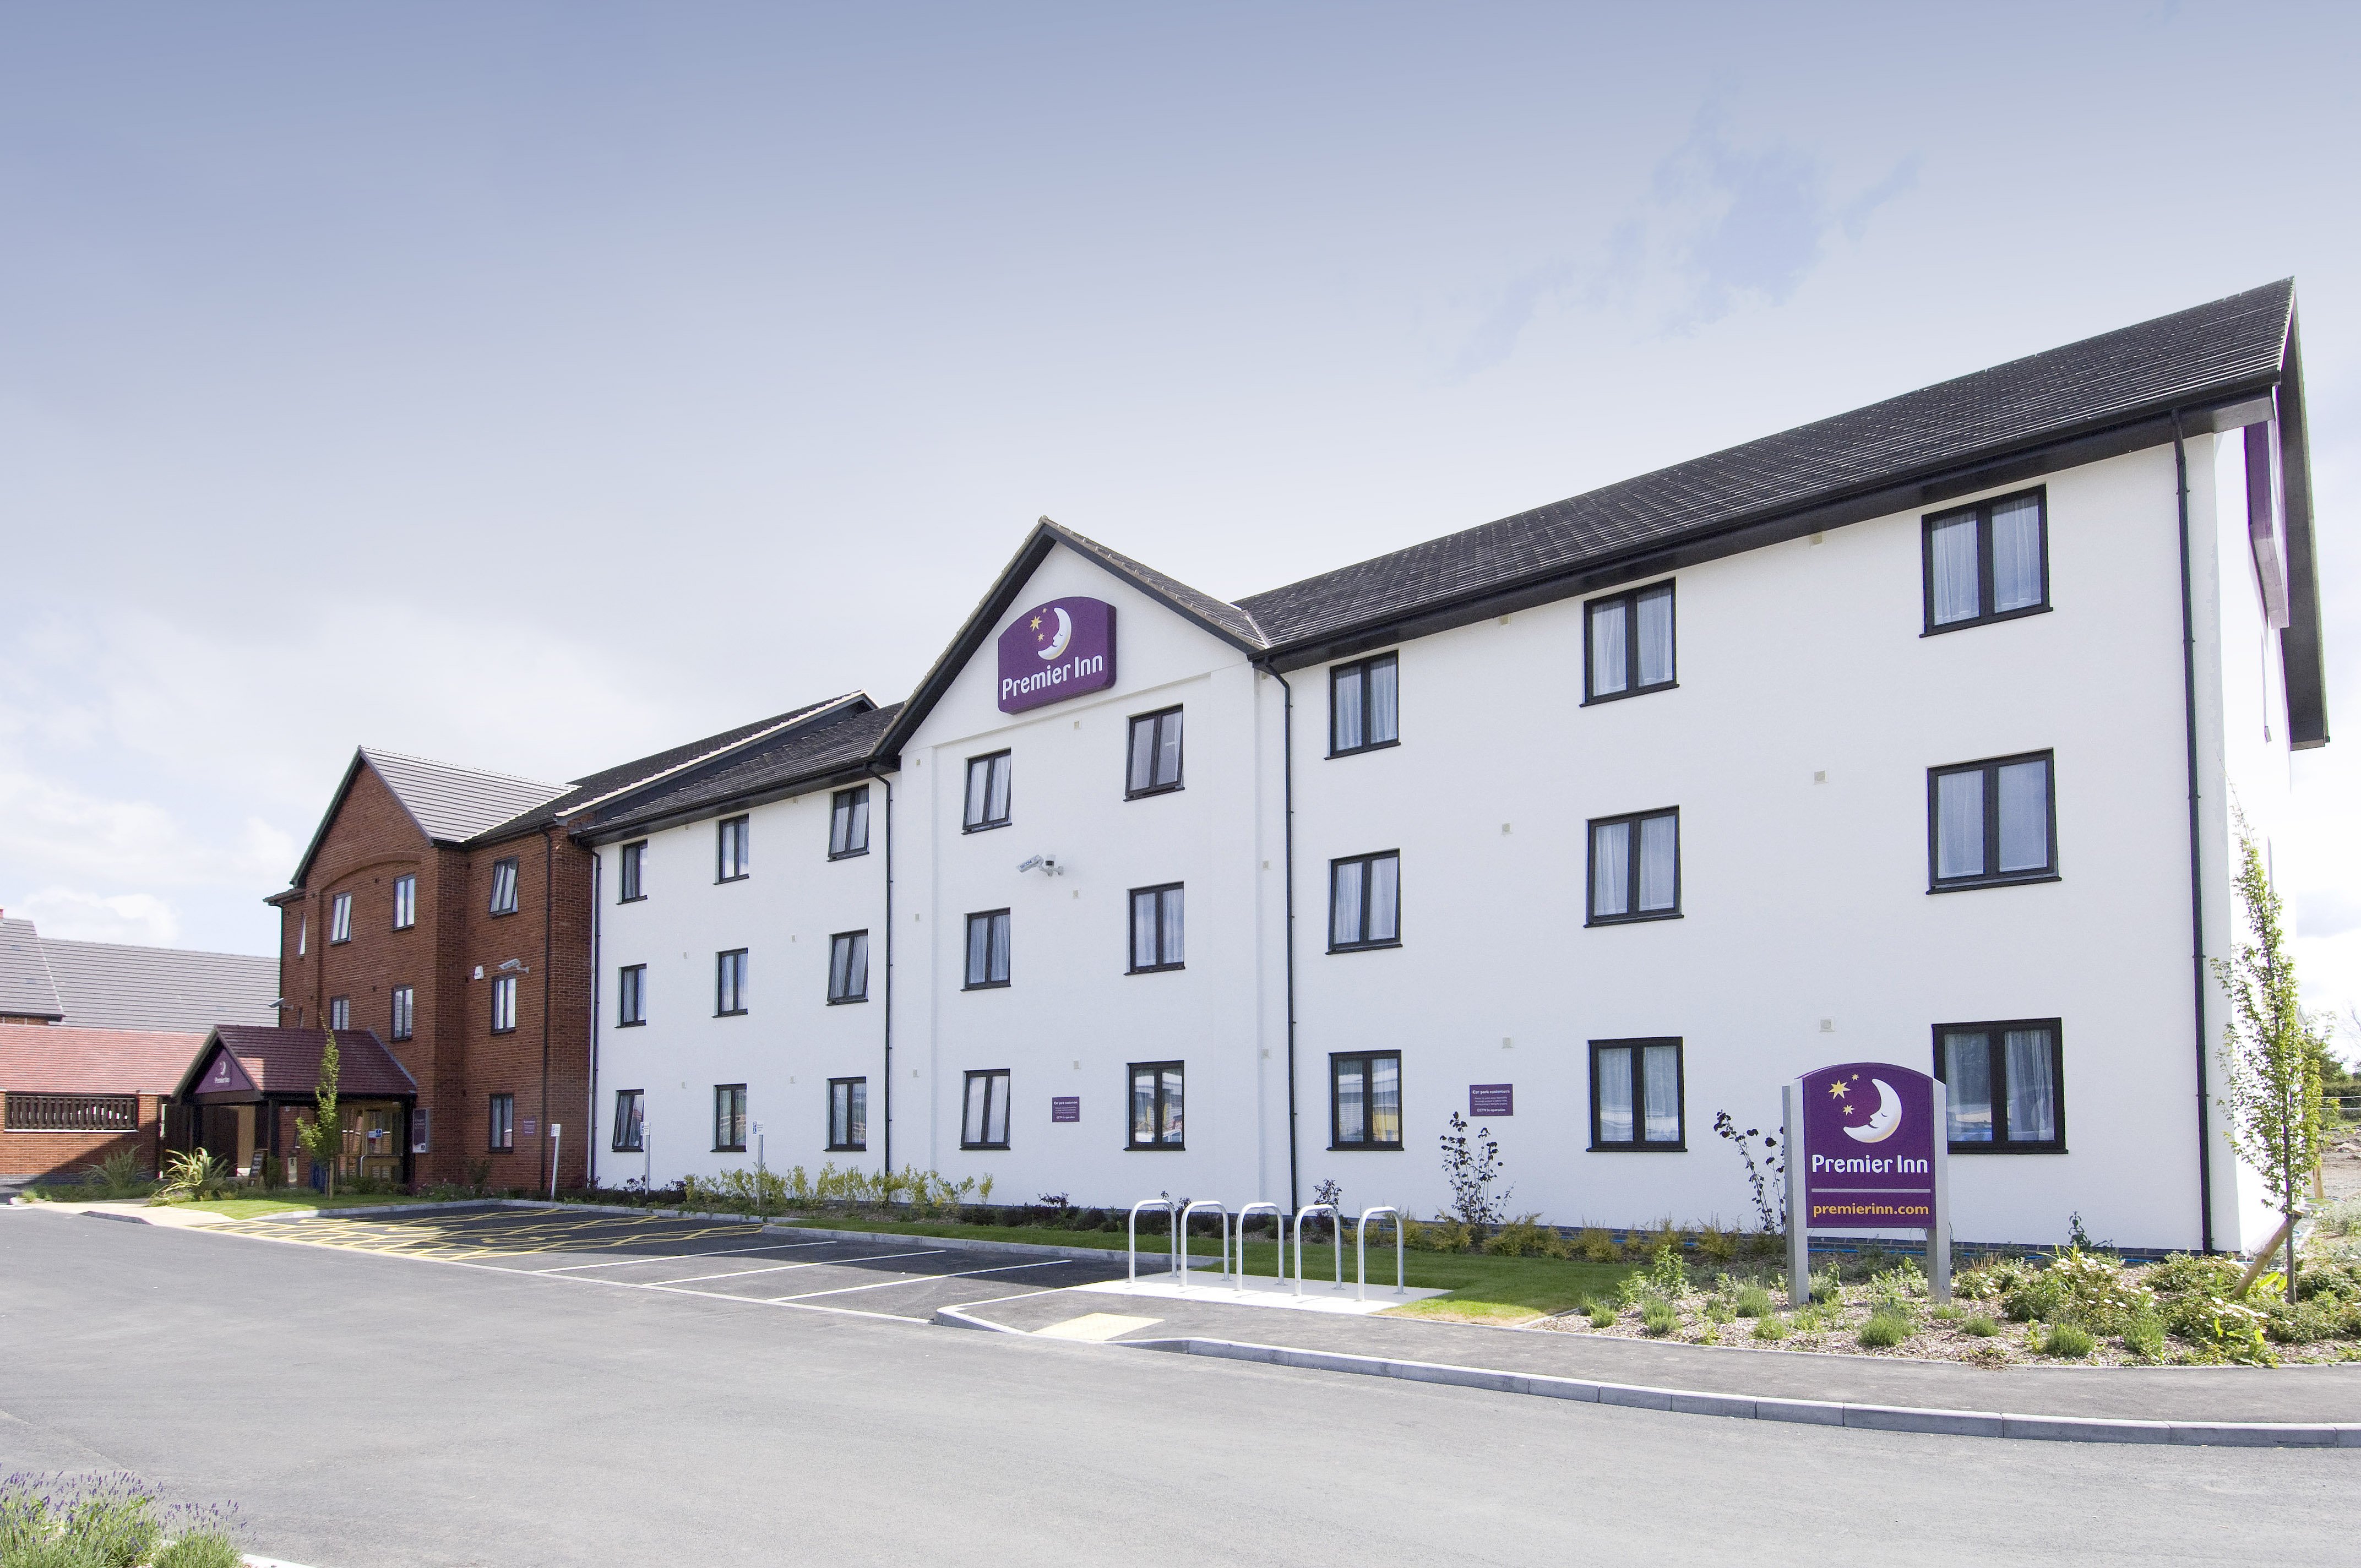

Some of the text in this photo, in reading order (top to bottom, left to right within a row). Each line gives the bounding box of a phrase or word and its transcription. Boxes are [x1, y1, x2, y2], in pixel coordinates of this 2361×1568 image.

[1002, 655, 1103, 700] Premier Inn
[1812, 1155, 1928, 1173] Premier Inn
[1813, 1202, 1929, 1217] premierinn.com
